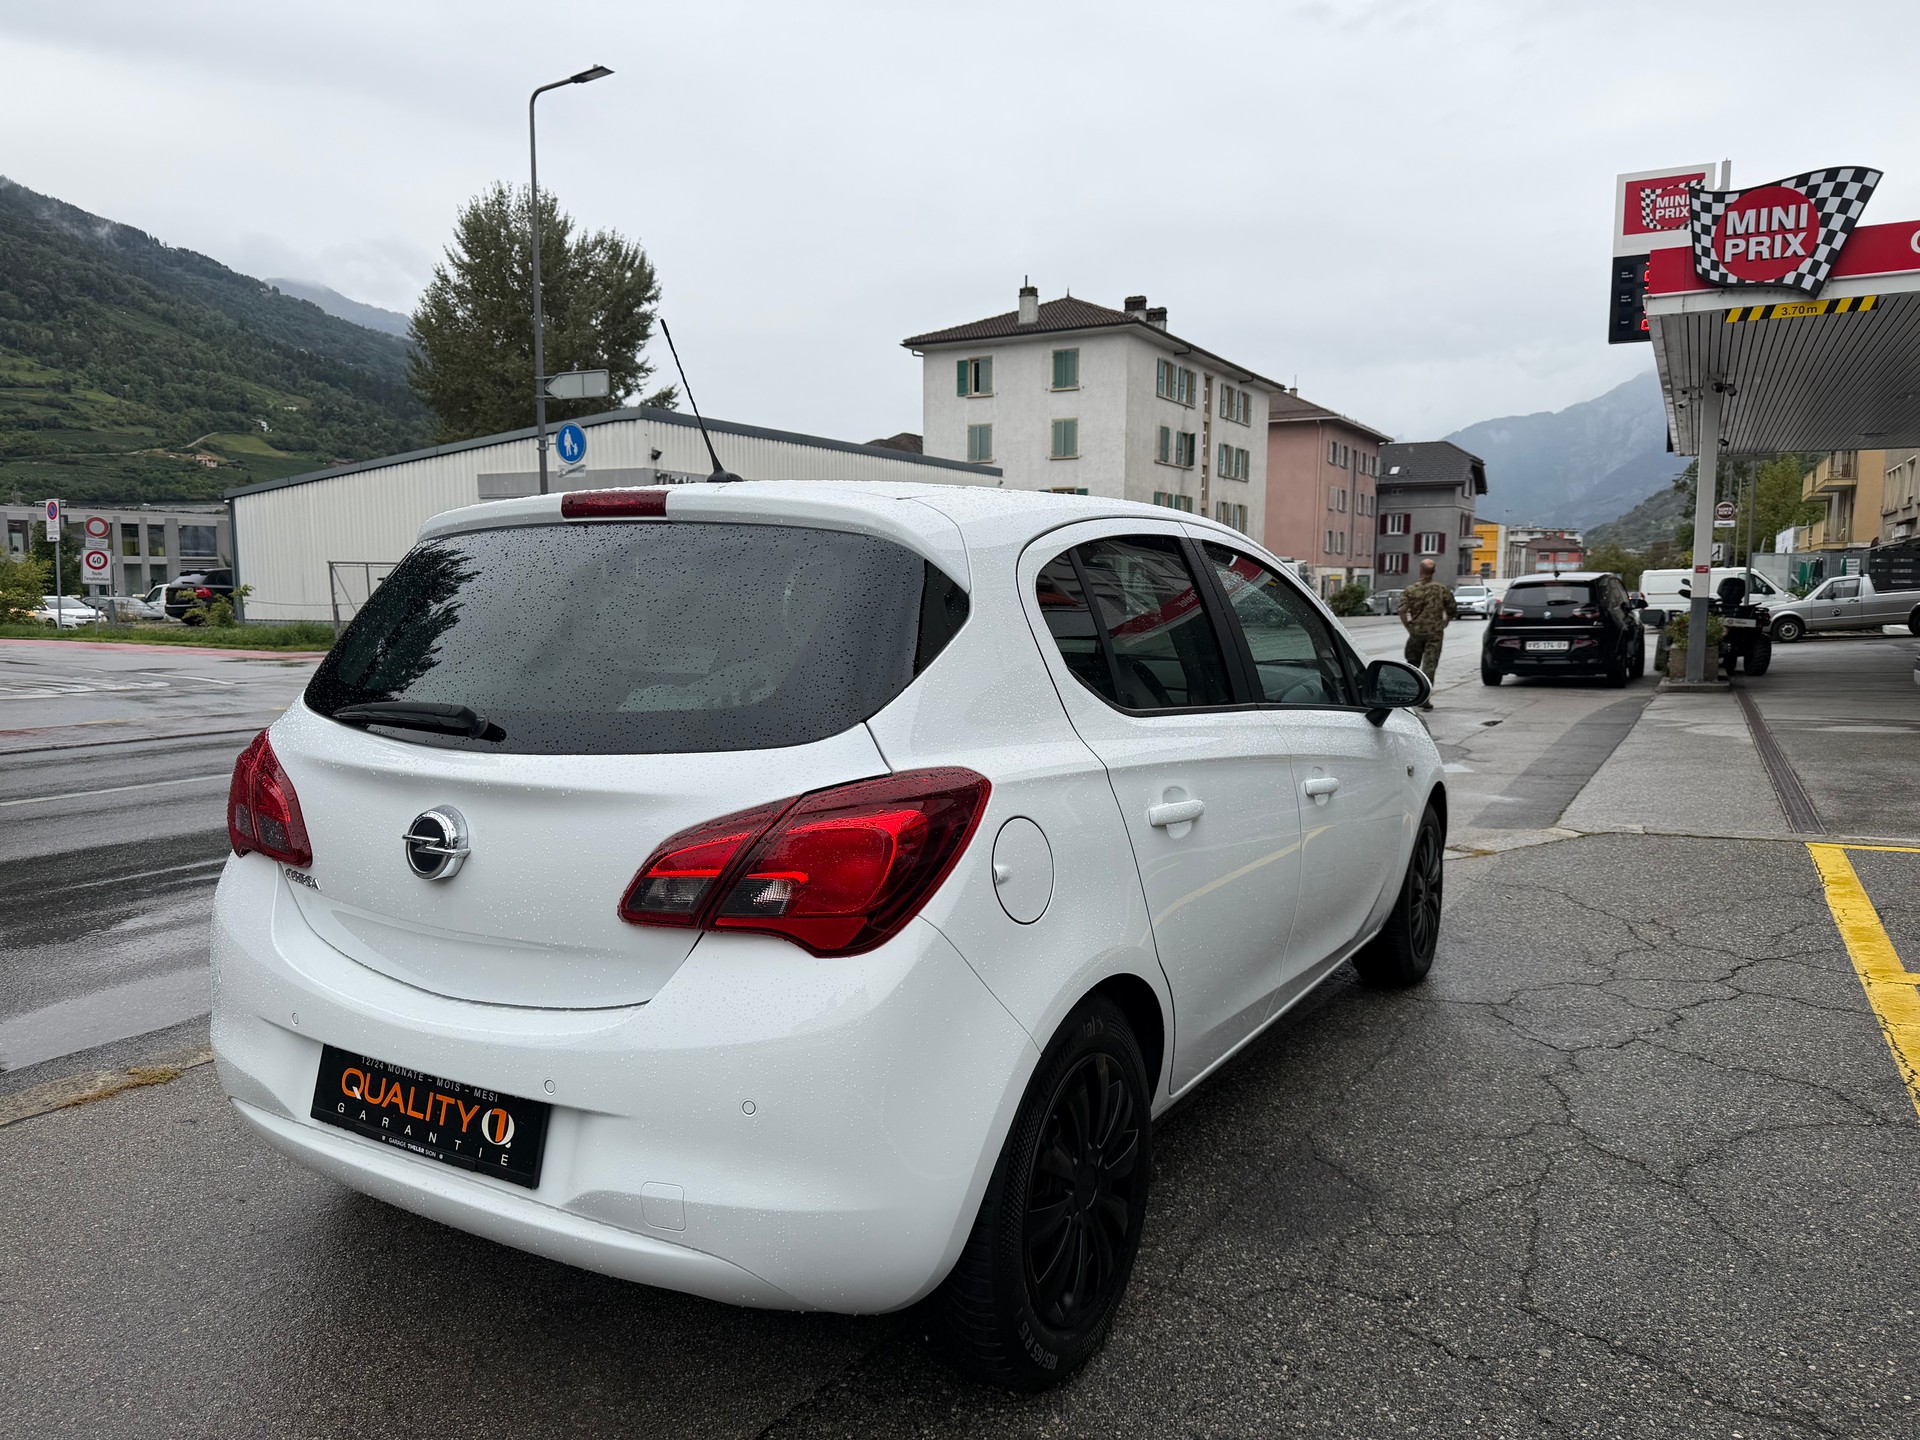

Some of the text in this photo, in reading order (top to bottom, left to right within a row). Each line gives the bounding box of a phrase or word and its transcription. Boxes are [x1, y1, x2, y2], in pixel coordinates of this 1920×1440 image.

[1656, 194, 1690, 208] MINI
[1655, 206, 1690, 220] PRIX
[1725, 203, 1808, 236] MINI
[1723, 232, 1808, 263] PRIX
[1781, 305, 1818, 316] 3.70 m
[92, 556, 102, 564] 40
[362, 1056, 384, 1070] 12/24
[387, 1063, 424, 1082] MONATE
[436, 1078, 461, 1092] MOIS
[473, 1088, 498, 1103] MESI
[341, 1068, 480, 1133] QUALITY
